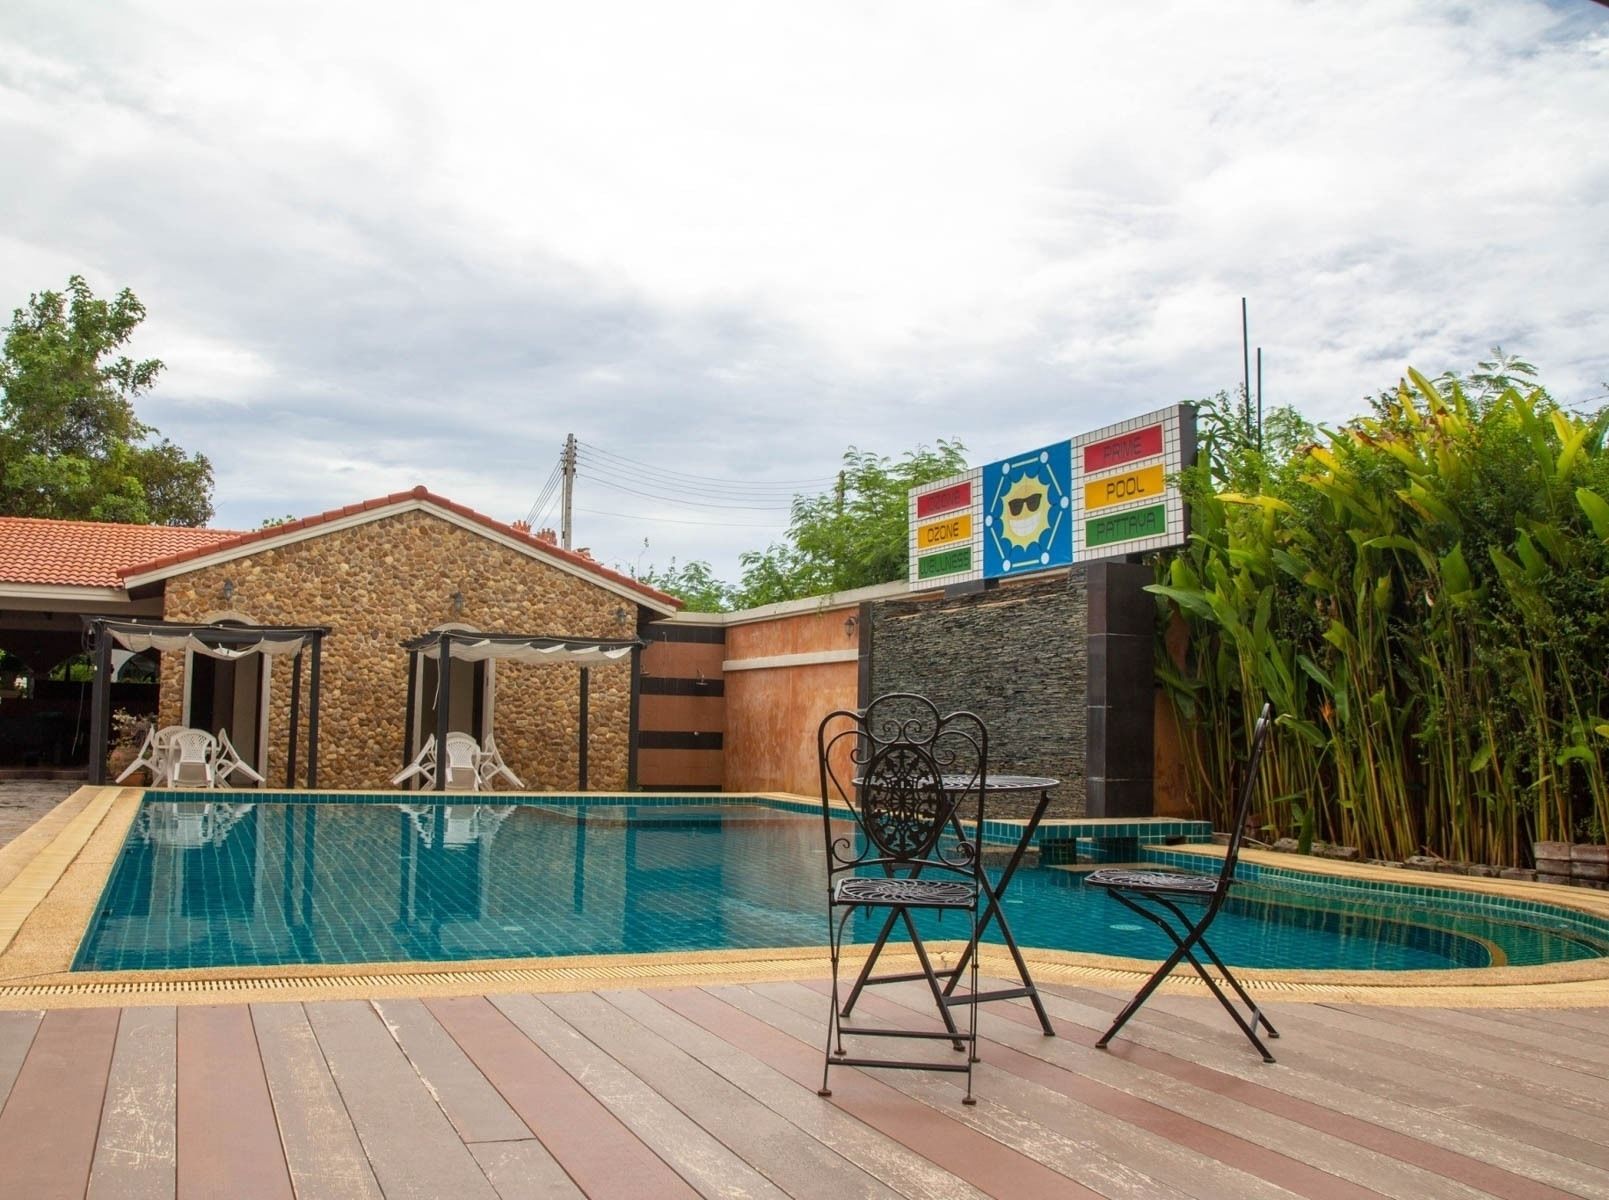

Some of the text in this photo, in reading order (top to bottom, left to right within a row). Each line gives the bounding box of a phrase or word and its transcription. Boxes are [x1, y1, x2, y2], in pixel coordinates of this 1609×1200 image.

[1103, 436, 1142, 460] PRIME
[1106, 475, 1145, 500] POOL
[927, 522, 959, 543] OZONE
[1096, 511, 1156, 540] PATTAYA
[920, 551, 969, 575] WELLNESS
